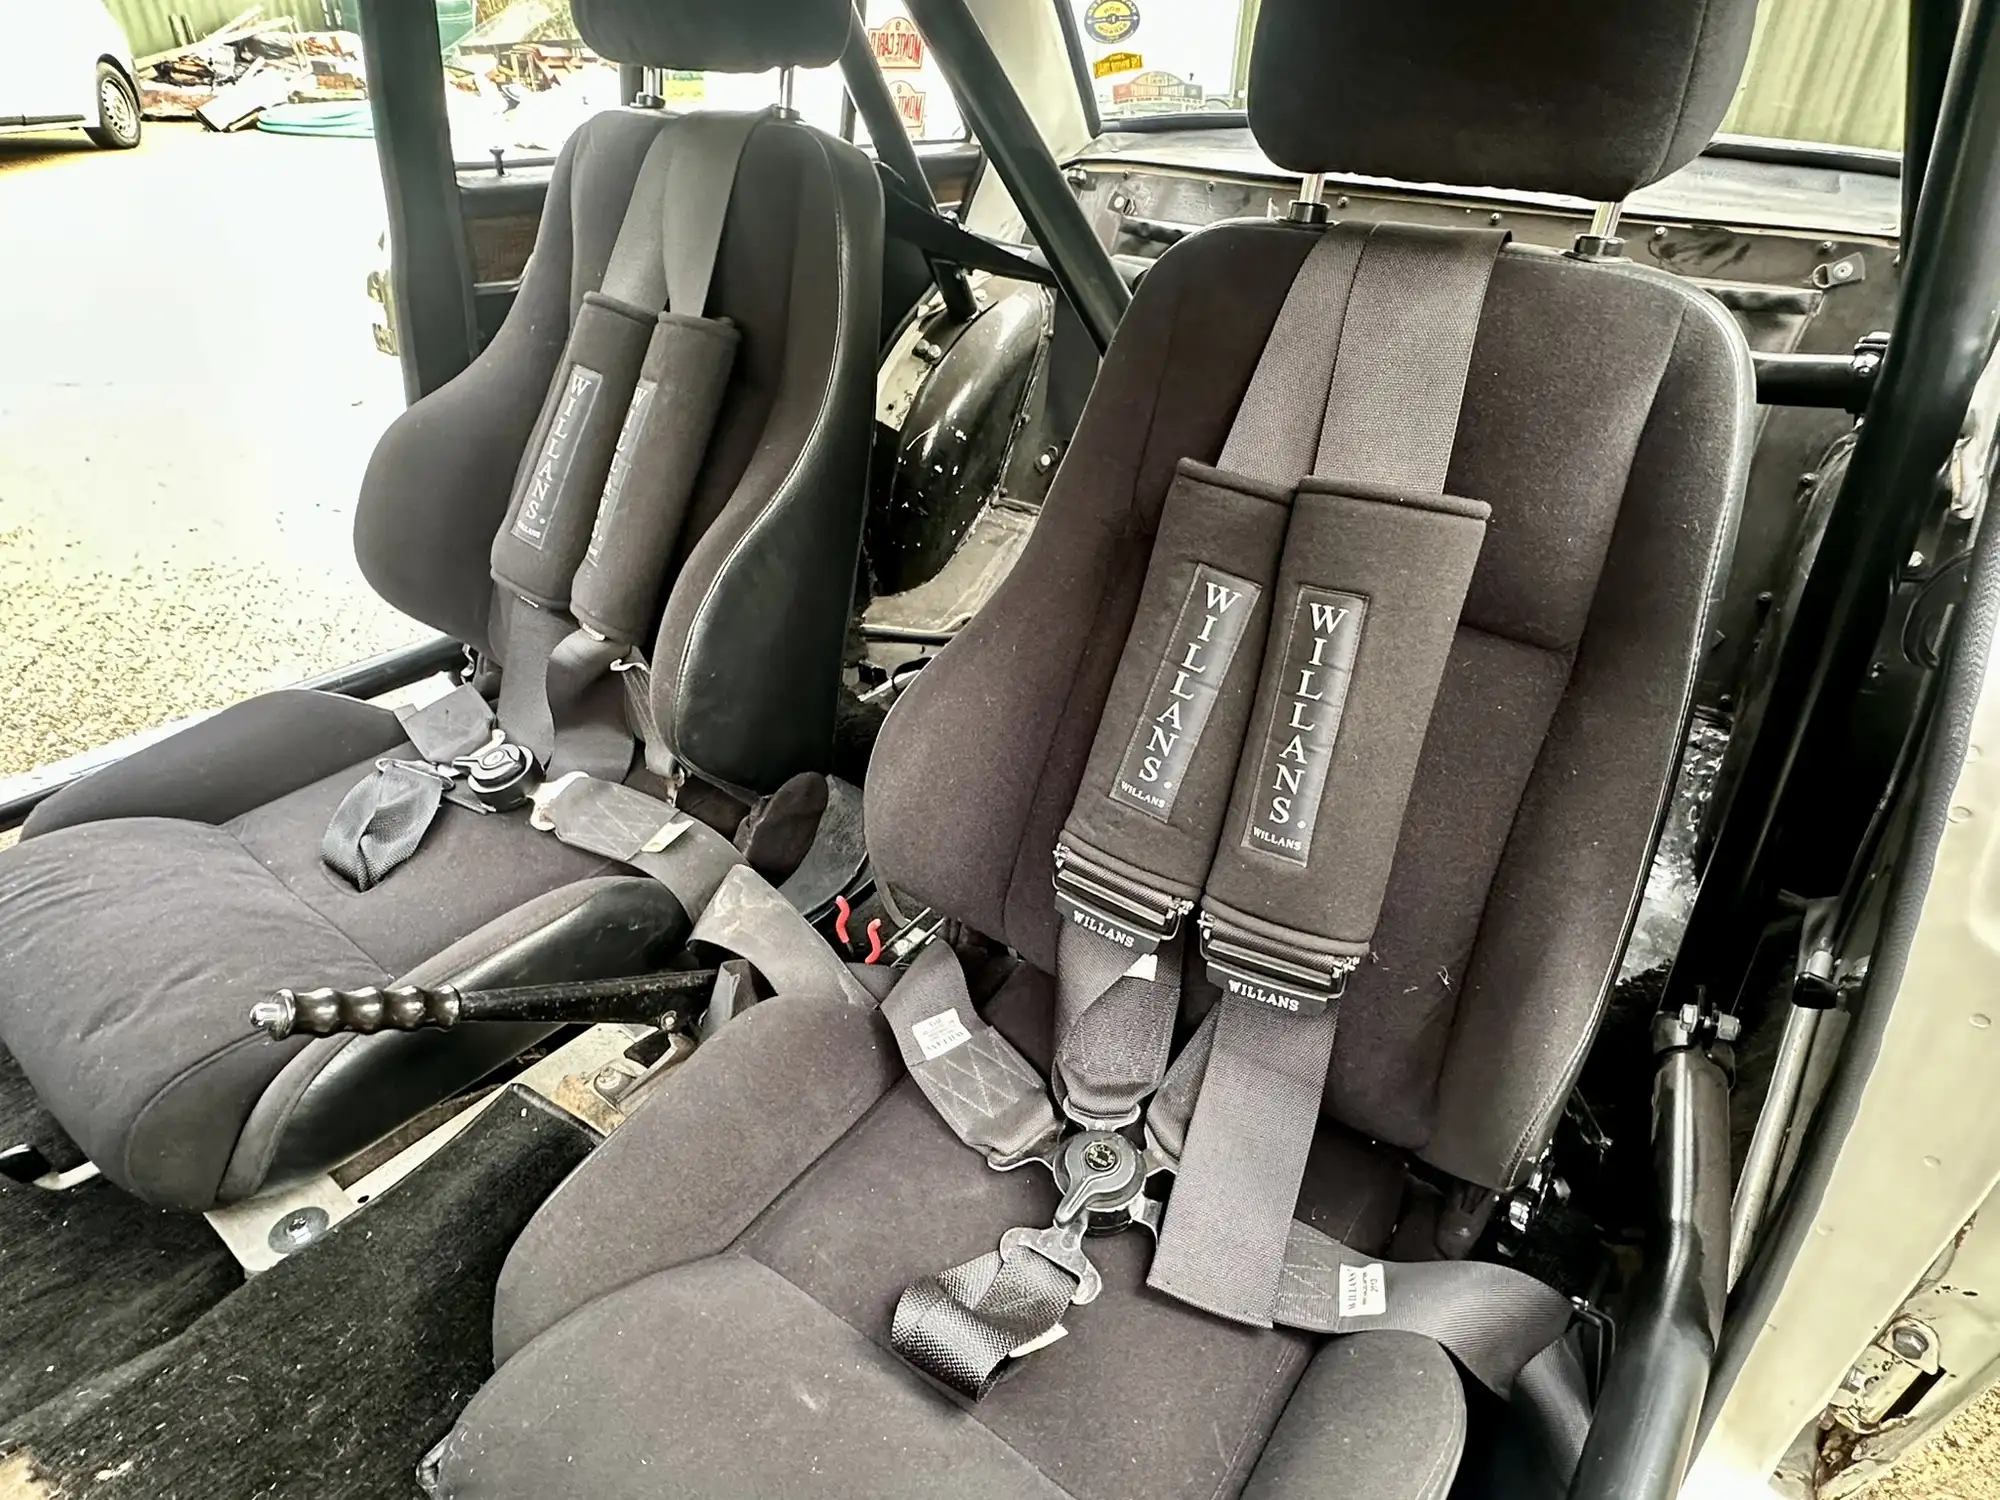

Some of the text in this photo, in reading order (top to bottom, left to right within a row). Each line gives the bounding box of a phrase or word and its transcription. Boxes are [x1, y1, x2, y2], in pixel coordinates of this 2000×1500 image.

[1120, 781, 1166, 809] WILLANS
[1252, 826, 1303, 852] WILLANS
[1073, 909, 1135, 949] WILLANS
[1228, 979, 1300, 1012] WILLANS
